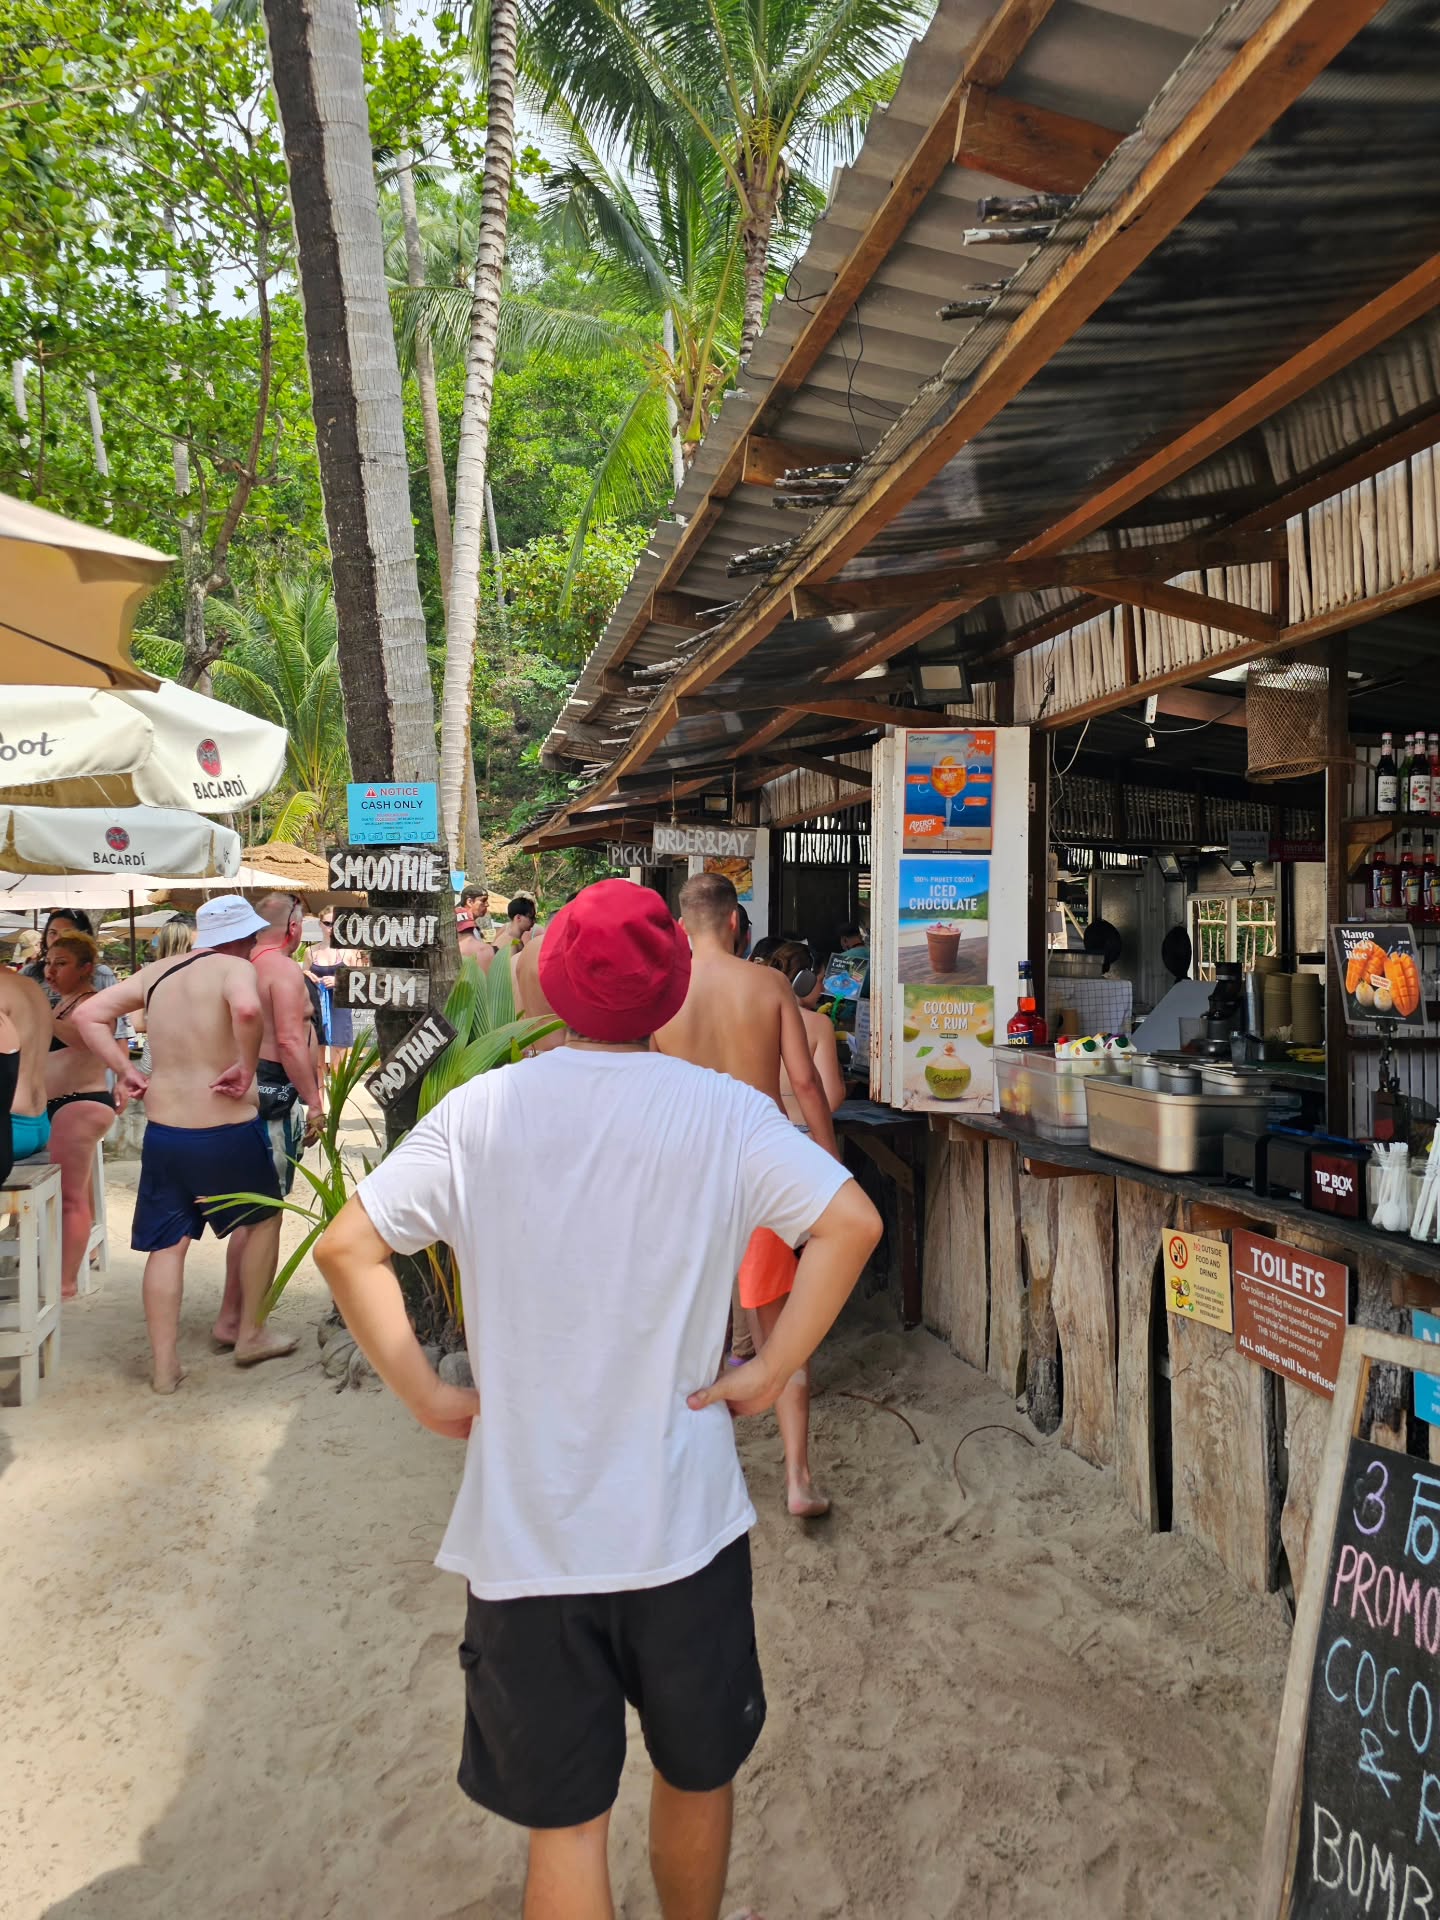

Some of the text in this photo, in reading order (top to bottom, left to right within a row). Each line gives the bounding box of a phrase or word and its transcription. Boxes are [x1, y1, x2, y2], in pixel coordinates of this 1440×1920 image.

[193, 775, 248, 800] BACARDÍ
[380, 787, 419, 796] NOTICE
[361, 800, 423, 810] CASH ONLY
[909, 818, 937, 831] APEROL
[93, 851, 146, 866] BACARDÍ
[329, 852, 442, 892] SMOOTHIE
[909, 897, 978, 911] CHOCOLATE
[929, 884, 957, 897] ICED
[333, 913, 438, 948] COCONUT
[1341, 929, 1375, 941] Mango
[348, 971, 416, 1007] RUM
[923, 1001, 975, 1015] COCONUT
[930, 1016, 969, 1030] & RUM
[370, 1016, 449, 1105] PAD THAI
[1315, 1170, 1353, 1192] TIP BOX
[1193, 1242, 1222, 1257] NO OUTSIDE
[1195, 1255, 1221, 1268] FOOD AND
[1199, 1267, 1218, 1280] DRINKS
[1250, 1247, 1326, 1298] TOILETS
[1241, 1282, 1251, 1292] Our
[1251, 1284, 1266, 1299] toilets
[1283, 1298, 1293, 1309] the
[1292, 1305, 1302, 1313] use
[1302, 1308, 1310, 1317] of
[1309, 1311, 1337, 1330] customers
[1248, 1299, 1259, 1310] with
[1288, 1313, 1313, 1332] spending
[1313, 1325, 1320, 1335] at
[1319, 1330, 1330, 1339] our
[1258, 1324, 1268, 1337] THB
[1269, 1329, 1278, 1342] 100
[1278, 1335, 1288, 1346] per
[1288, 1339, 1306, 1354] person
[1265, 1315, 1279, 1330] shop
[1279, 1321, 1289, 1333] and
[1289, 1328, 1316, 1346] restaurant
[1316, 1340, 1323, 1349] of
[1240, 1335, 1254, 1351] ALL
[1254, 1342, 1280, 1364] others
[1281, 1355, 1296, 1372] will
[1296, 1363, 1307, 1378] be
[1353, 1460, 1388, 1534] 3
[1333, 1545, 1440, 1655] PROMO
[1325, 1636, 1433, 1753] COCO
[1358, 1727, 1402, 1799] &
